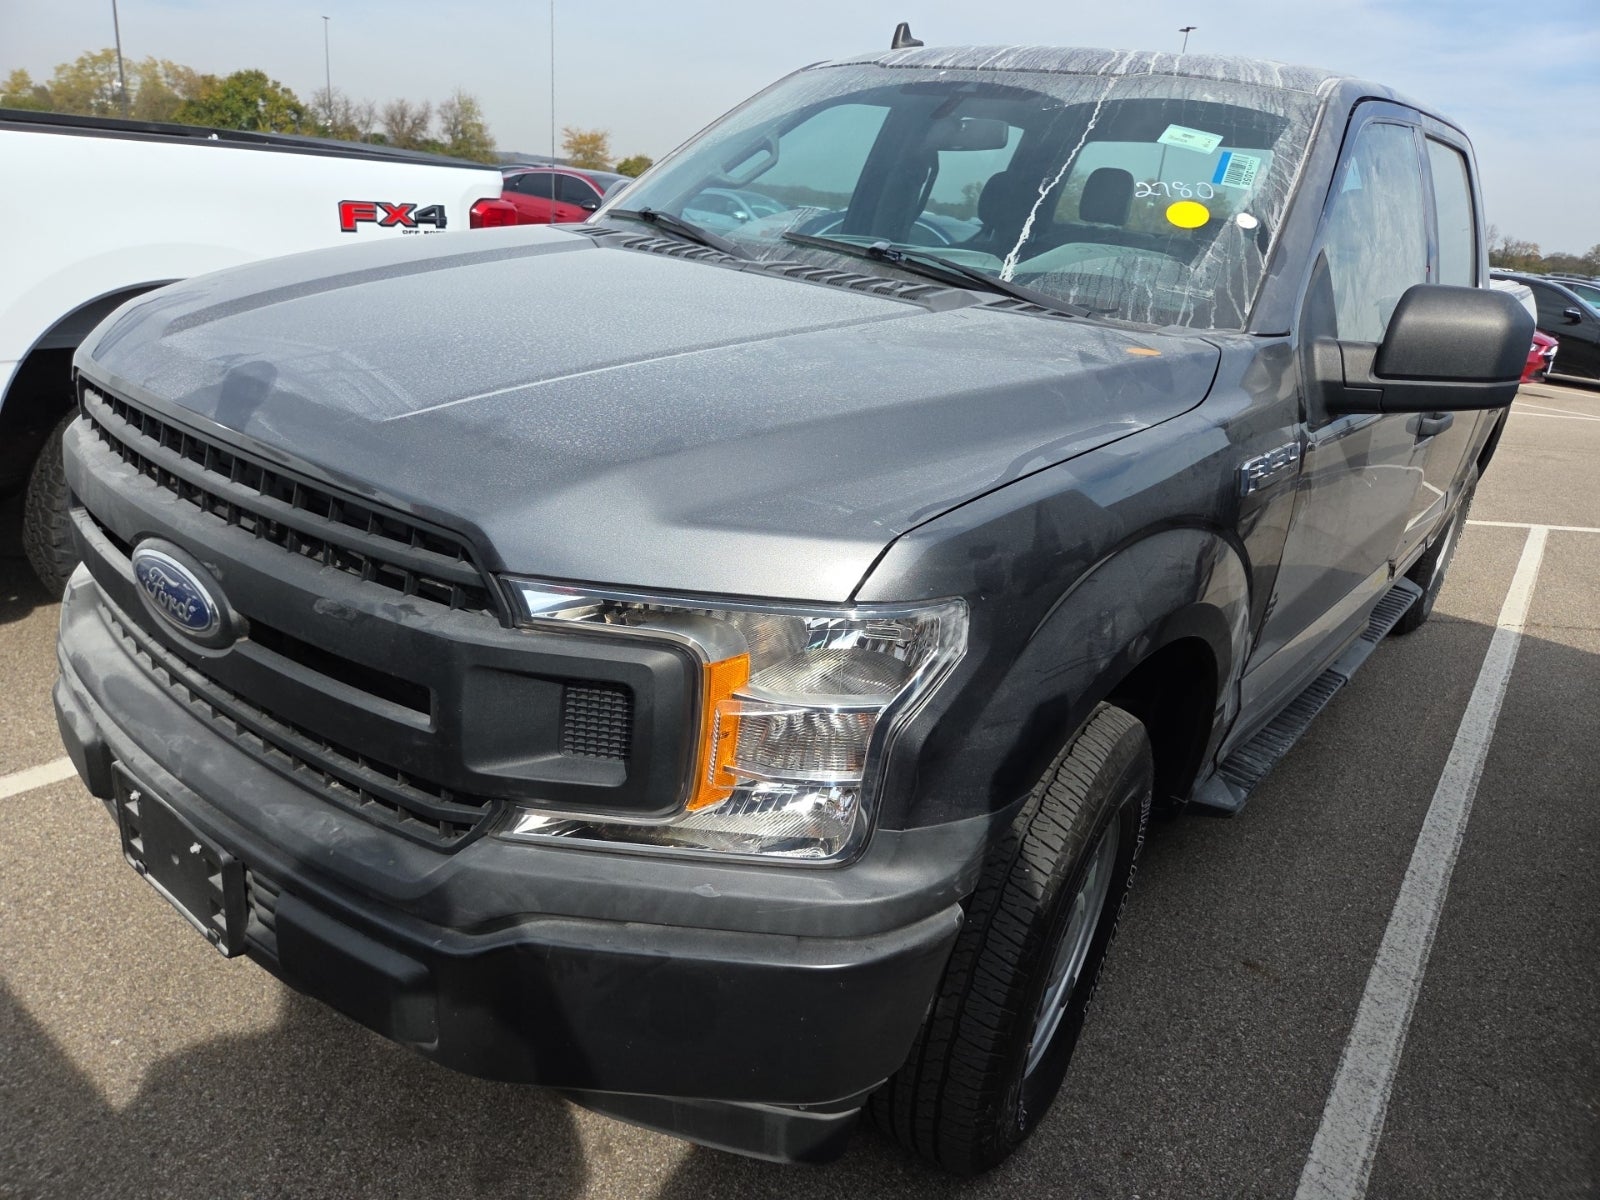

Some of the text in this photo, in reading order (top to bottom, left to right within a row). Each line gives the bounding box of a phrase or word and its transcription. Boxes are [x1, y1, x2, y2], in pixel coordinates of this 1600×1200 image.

[1135, 181, 1214, 199] 2780
[338, 200, 447, 232] FX4
[146, 566, 196, 622] Ford
